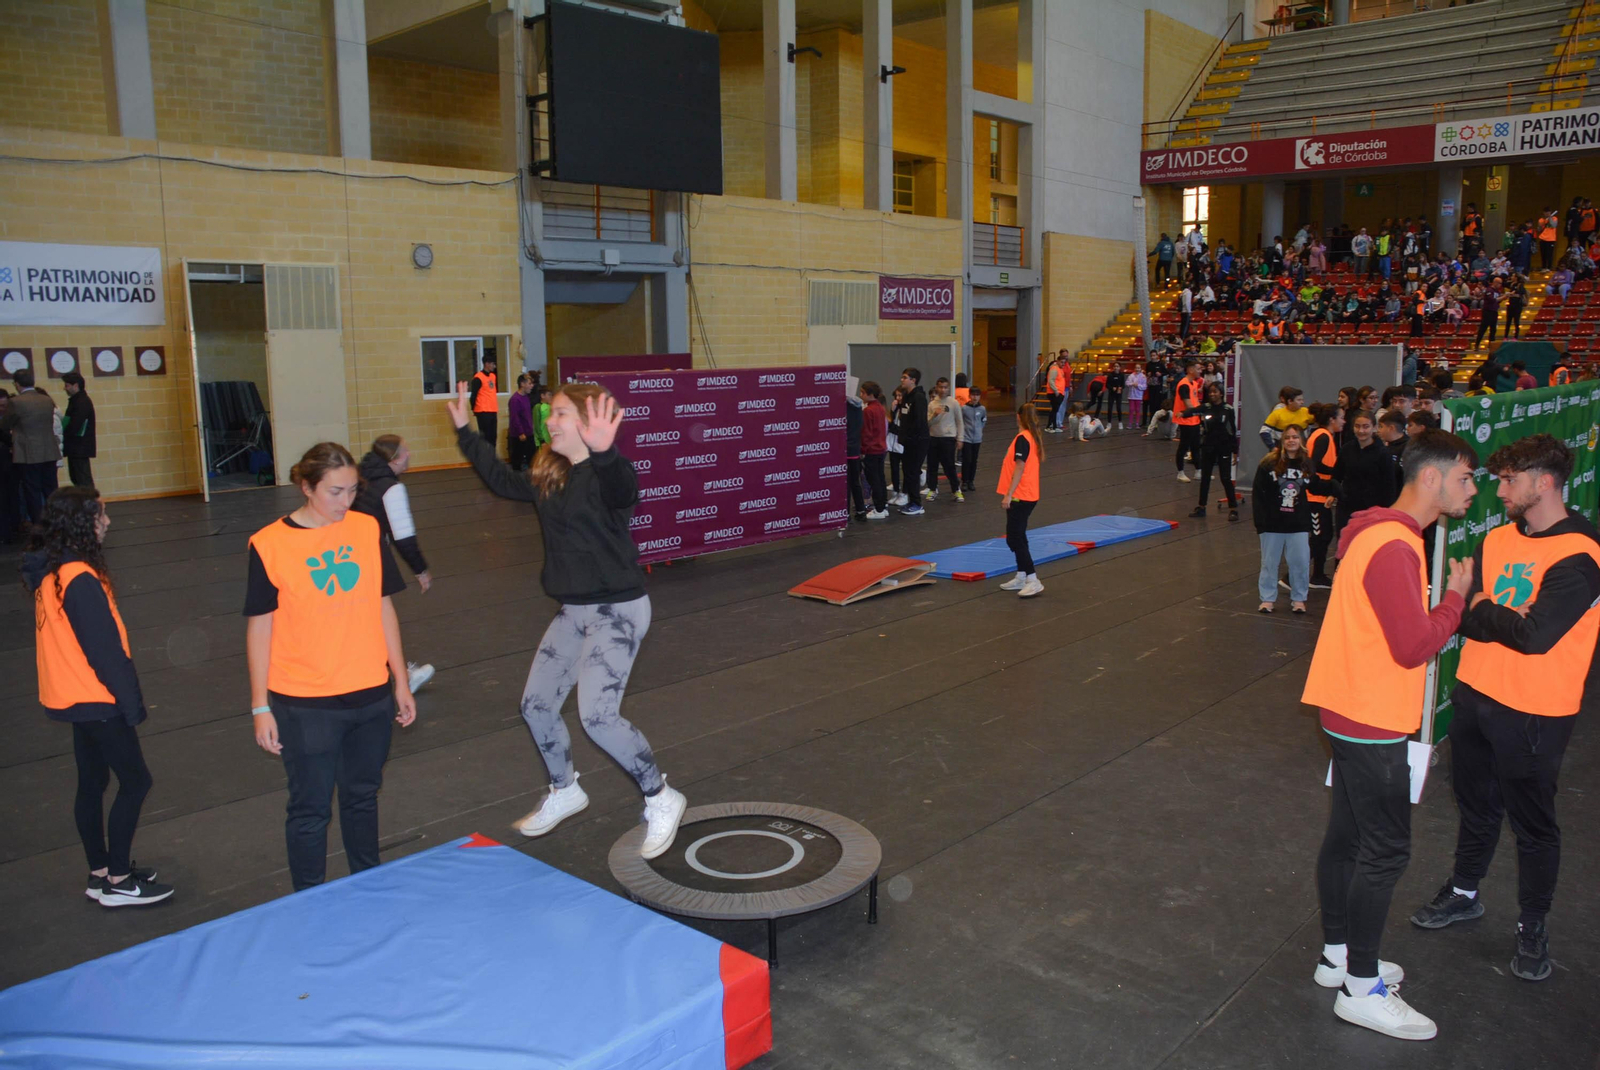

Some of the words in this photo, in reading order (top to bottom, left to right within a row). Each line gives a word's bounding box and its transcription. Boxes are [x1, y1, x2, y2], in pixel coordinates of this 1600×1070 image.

[1522, 112, 1600, 133] PATRIMO
[1329, 139, 1387, 153] Diputación
[1441, 141, 1507, 157] CÓRDOBA
[1168, 146, 1248, 169] IMDECO
[1329, 154, 1342, 164] de
[1344, 151, 1387, 163] Córdoba
[1167, 170, 1191, 178] Municipal
[1200, 168, 1223, 176] Deportes
[1360, 185, 1368, 194] A
[27, 268, 141, 286] PATRIMONIO
[143, 271, 153, 279] DE
[28, 285, 156, 303] HUMANIDAD
[899, 287, 952, 305] IMDECO
[639, 378, 674, 388] IMDECO
[706, 376, 737, 385] IMDECO
[767, 373, 795, 383] IMDECO
[747, 399, 776, 409] IMDECO
[803, 395, 830, 405] IMDECO
[622, 406, 650, 416] DECO
[684, 402, 716, 413] IMDECO
[772, 421, 800, 431] IMDECO
[826, 417, 847, 427] IMDEC
[646, 430, 680, 442] IMDECO
[712, 426, 743, 437] IMDECO
[747, 447, 776, 458] IMDECO
[804, 441, 830, 452] IMDECO
[684, 453, 717, 465] IMDECO
[826, 464, 847, 474] IMDEC
[772, 470, 800, 481] IMDECO
[712, 477, 744, 489] IMDECO
[646, 484, 681, 497] IMDECO
[804, 489, 830, 500] IMDECO
[748, 497, 777, 509] IMDECO
[685, 505, 718, 518] IMDECO
[826, 508, 847, 520] IMDEC
[629, 514, 652, 526] DECO
[772, 517, 800, 529] IMDECO
[713, 526, 744, 539] IMDECO
[648, 536, 681, 550] IMDECO
